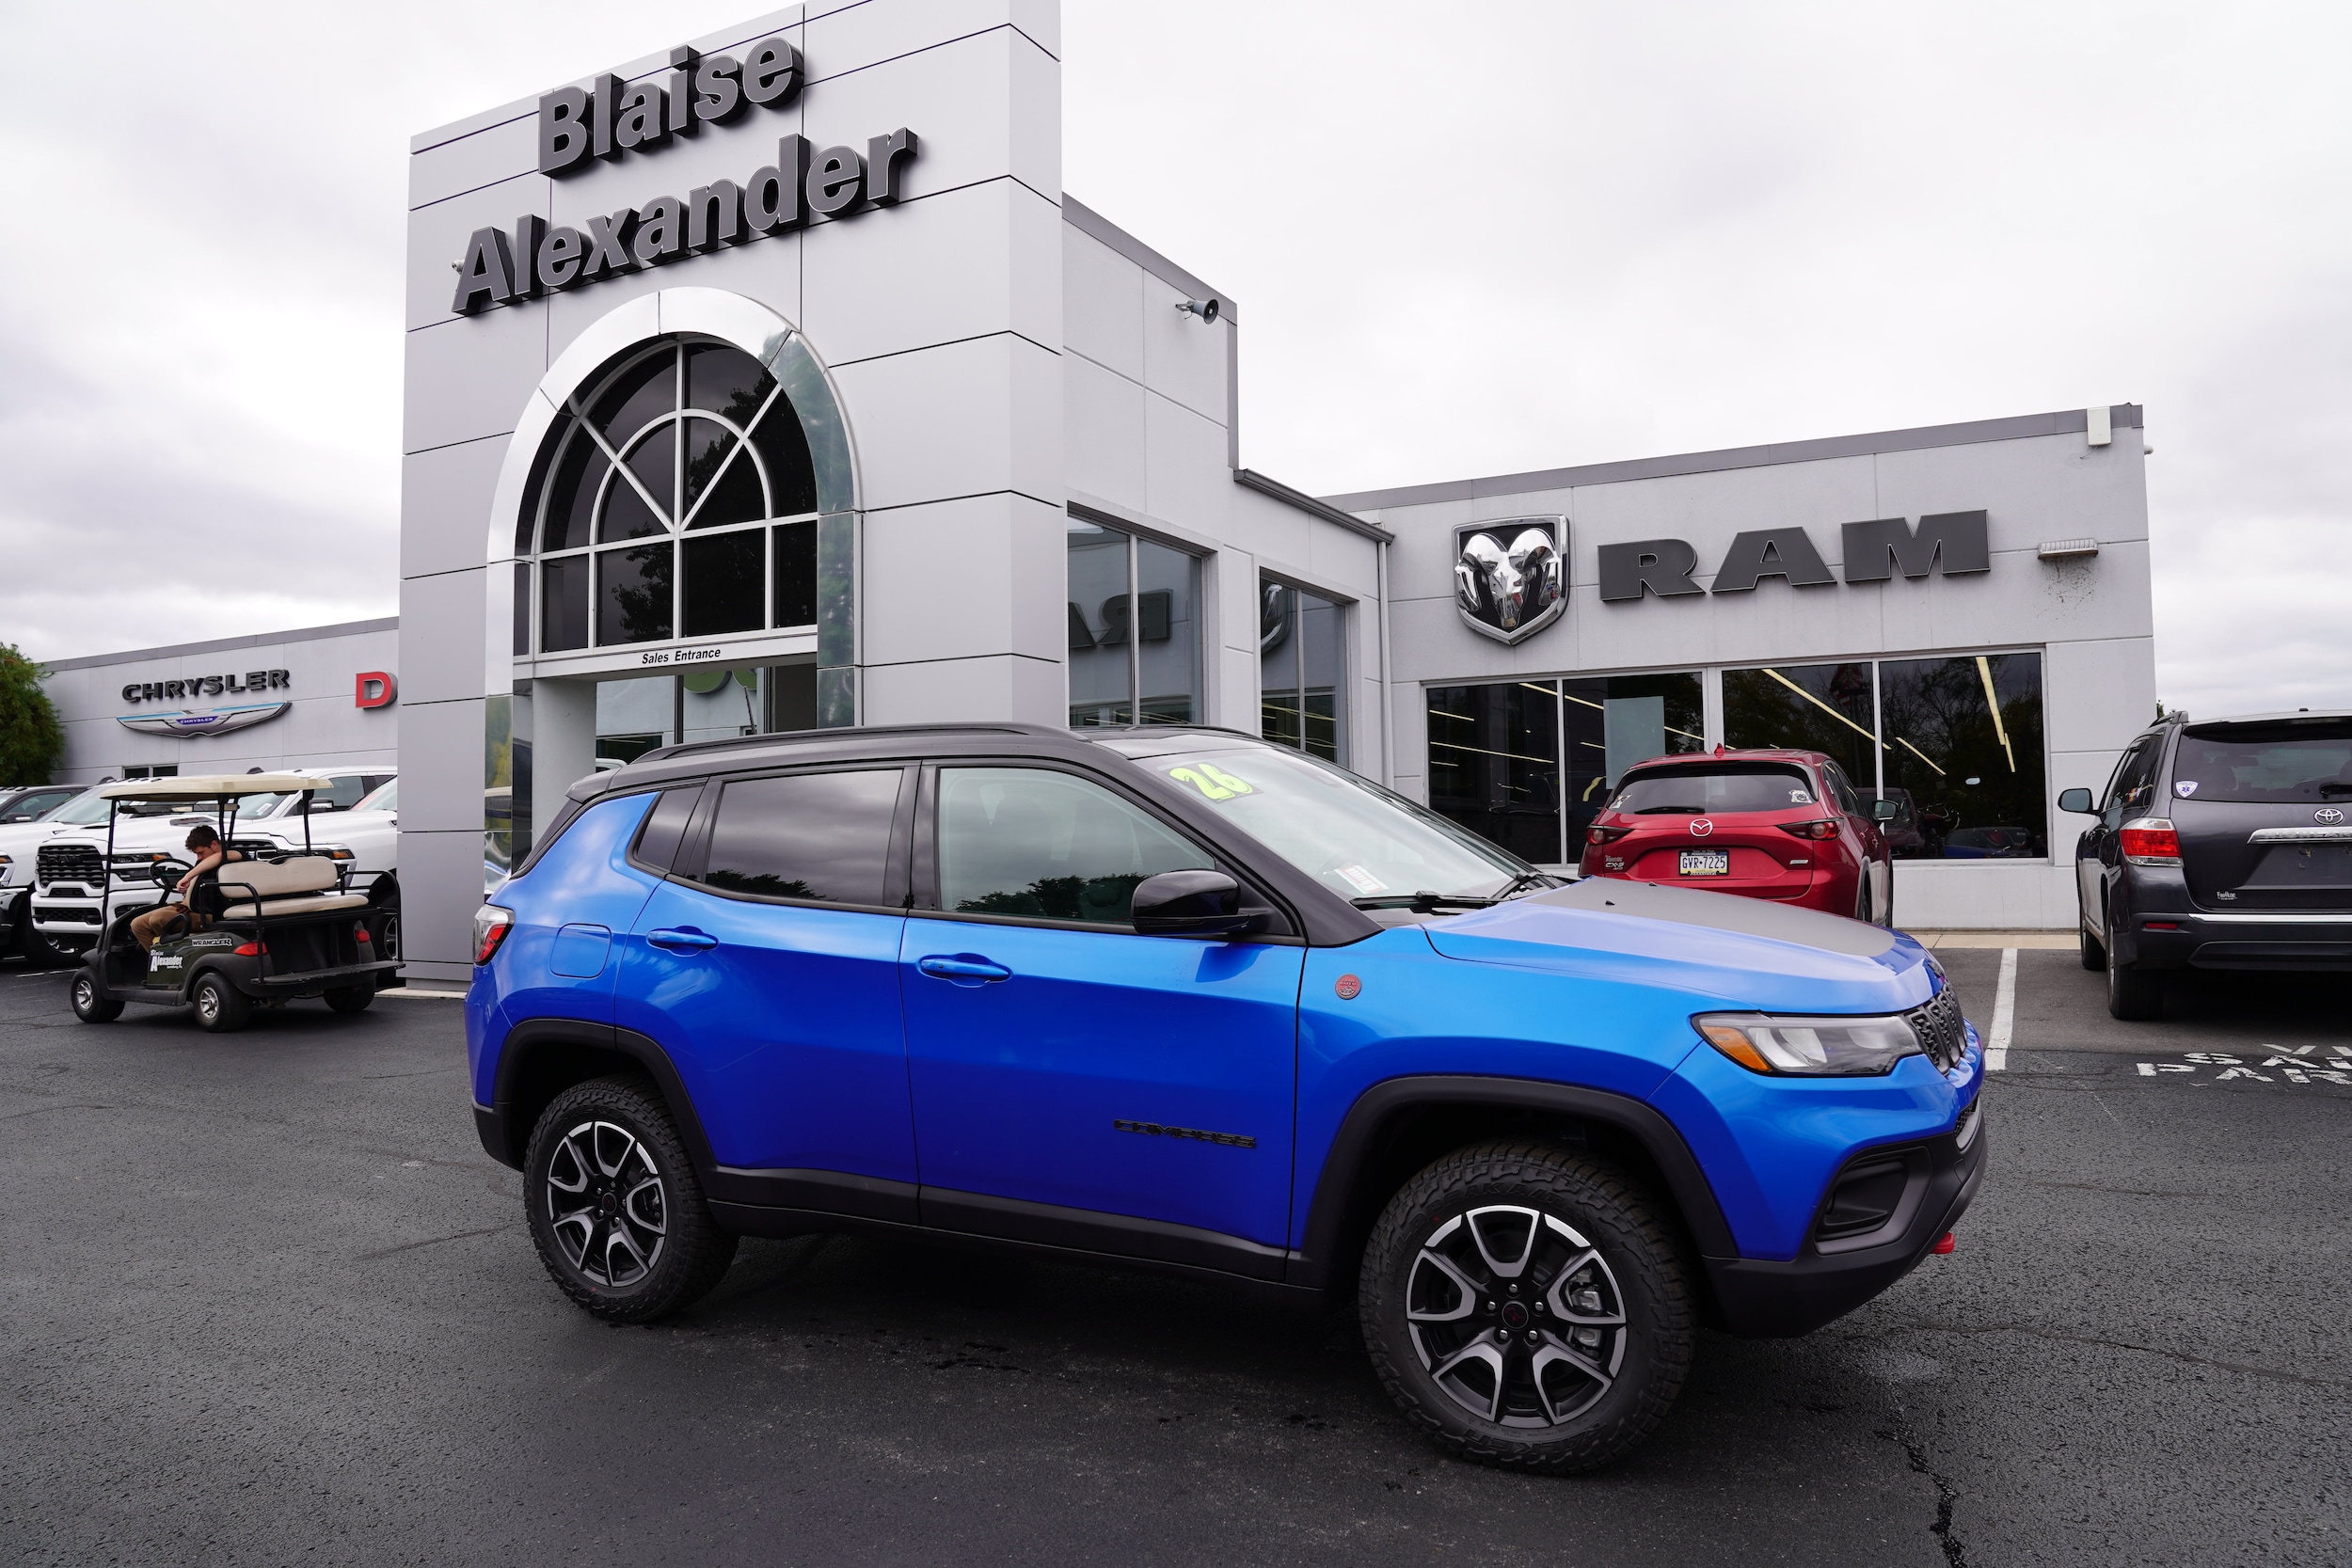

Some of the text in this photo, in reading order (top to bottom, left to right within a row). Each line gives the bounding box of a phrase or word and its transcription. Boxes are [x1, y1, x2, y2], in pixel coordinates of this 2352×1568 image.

[538, 36, 804, 179] Blaise
[452, 127, 918, 316] Alexander
[1597, 509, 1991, 602] RAM
[642, 649, 721, 665] Sales Entrance
[121, 669, 290, 703] CHRYSLER
[1169, 763, 1253, 800] 26
[192, 938, 232, 946] WRANGLER
[151, 956, 183, 972] Alexander
